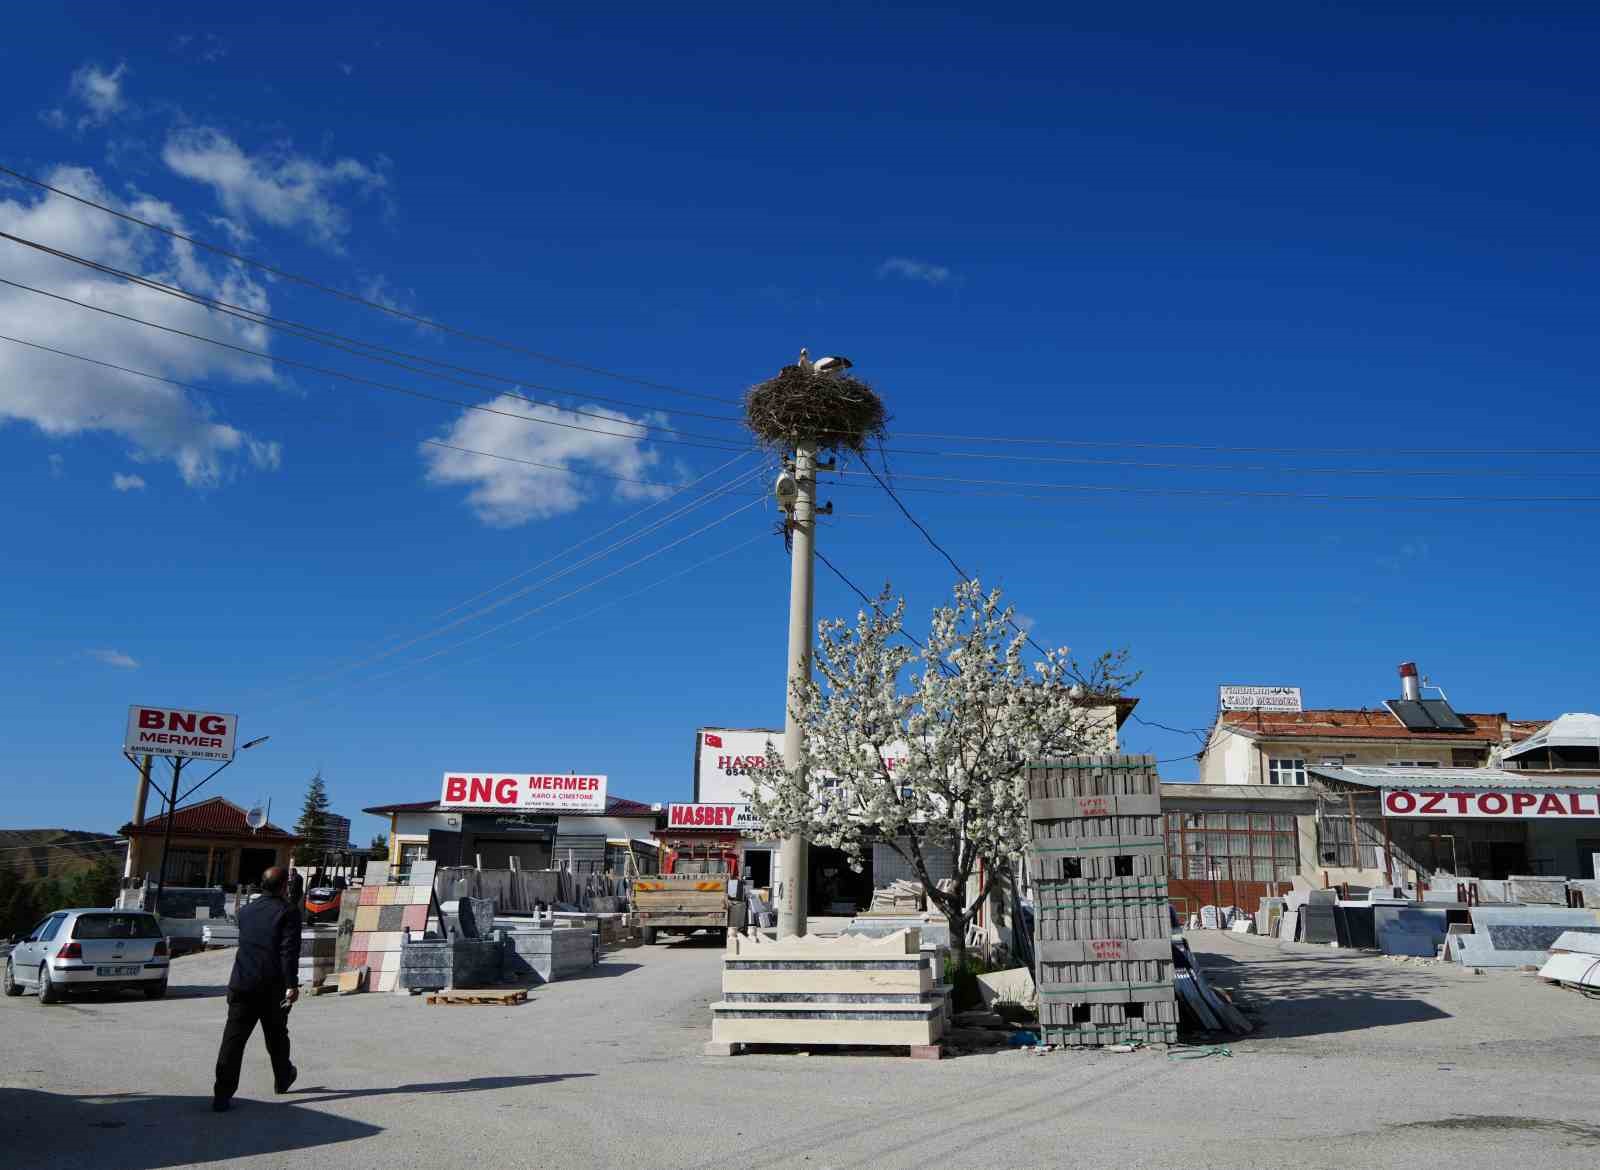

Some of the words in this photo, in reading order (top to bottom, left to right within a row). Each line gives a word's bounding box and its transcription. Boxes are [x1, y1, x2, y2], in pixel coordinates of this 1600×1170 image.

[139, 709, 226, 735] BNG
[140, 732, 222, 748] MERMER
[446, 777, 518, 804] BNG
[529, 777, 599, 791] MERMER
[1387, 789, 1600, 815] ÖZTOPAL
[671, 806, 735, 826] HASBEY
